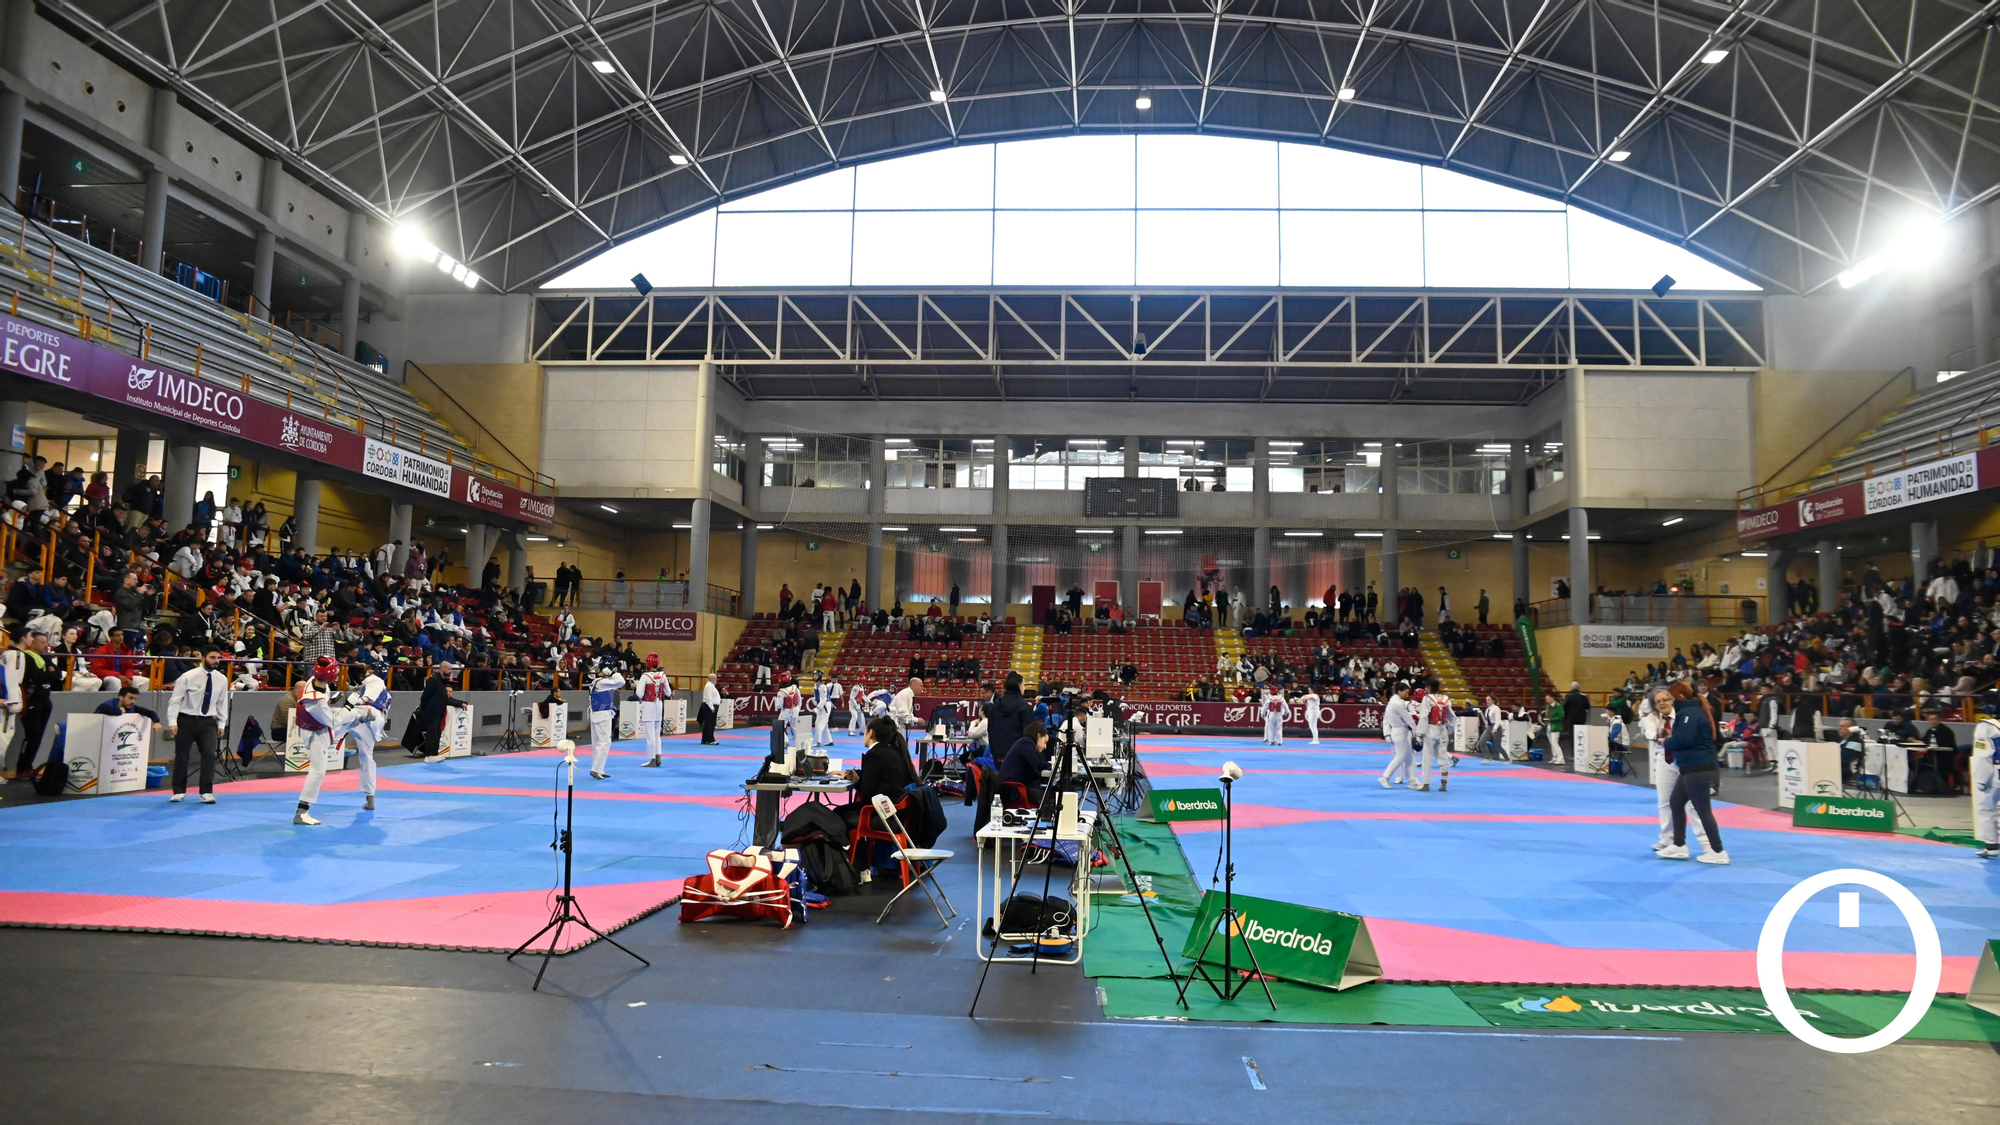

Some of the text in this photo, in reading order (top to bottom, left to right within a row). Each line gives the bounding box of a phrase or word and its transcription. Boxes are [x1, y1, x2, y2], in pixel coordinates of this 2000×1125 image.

[7, 321, 60, 347] DEPORTES
[0, 337, 72, 382] EGRE
[157, 371, 243, 420] IMDECO
[126, 393, 241, 434] Instituto Municipal de Deportes Córdoba
[299, 436, 305, 448] DE
[300, 424, 333, 444] AYUNTAMIENTO
[231, 467, 238, 478] D
[366, 461, 397, 479] CÓRDOBA
[404, 456, 445, 479] PATRIMONIO
[1907, 461, 1965, 486] PATRIMONIO
[402, 469, 448, 494] HUMANIDAD
[1908, 474, 1974, 501] HUMANIDAD
[481, 486, 504, 500] Diputación
[1868, 494, 1902, 510] CÓRDOBA
[527, 499, 555, 518] IMDECO
[1814, 498, 1844, 511] Diputación
[1745, 510, 1779, 530] IMDECO
[635, 617, 694, 630] IMDECO
[1175, 800, 1218, 811] Iberdrola
[1828, 805, 1884, 818] Iberdrola
[1244, 919, 1333, 956] Iberdrola
